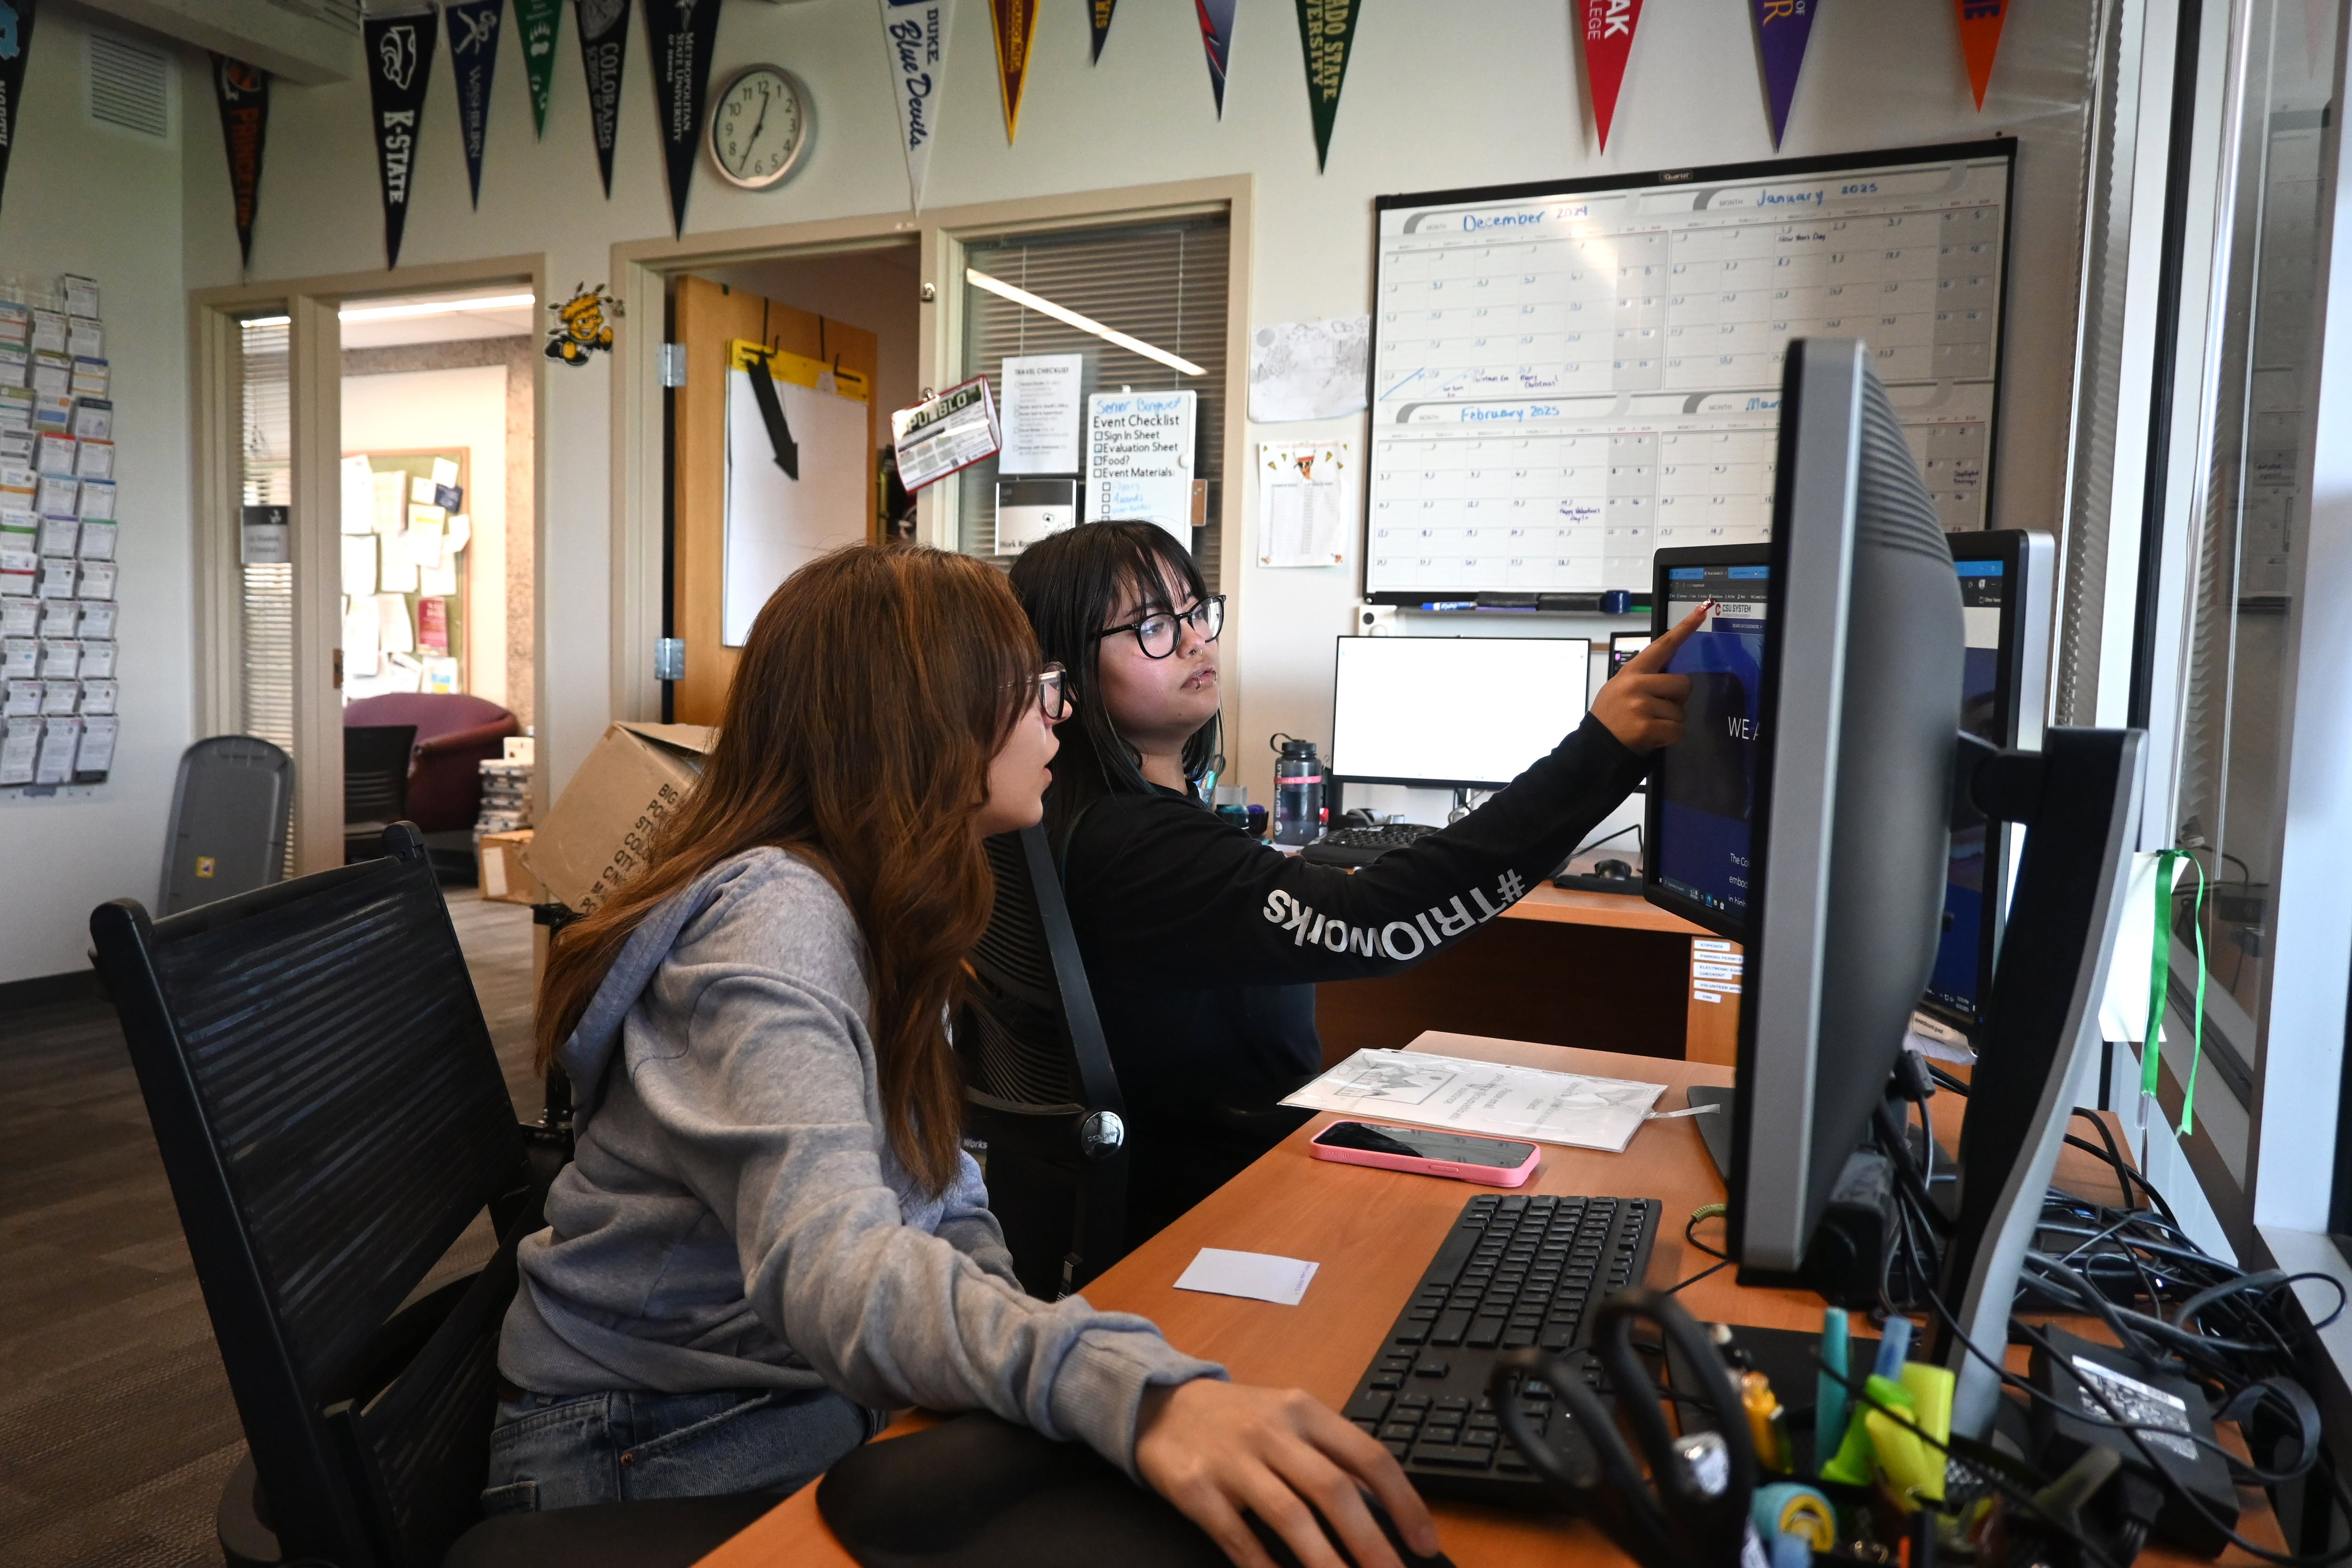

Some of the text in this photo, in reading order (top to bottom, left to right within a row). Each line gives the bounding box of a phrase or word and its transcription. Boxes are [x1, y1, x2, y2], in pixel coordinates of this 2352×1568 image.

[927, 8, 939, 65] DUKE
[1323, 40, 1344, 103] STATE
[673, 32, 685, 143] STATE UNIVERSITY
[683, 32, 695, 132] METROPOLITAN
[757, 80, 769, 95] 12
[889, 20, 932, 152] Blue Devils
[600, 42, 620, 150] COLORADO
[742, 87, 752, 101] 11
[776, 85, 781, 98] 1
[727, 102, 742, 117] 10
[786, 99, 793, 113] 2
[725, 122, 733, 136] 9
[729, 142, 736, 157] 8
[783, 138, 791, 153] 4
[383, 110, 414, 202] K-STATE
[771, 153, 779, 167] 5
[755, 160, 763, 174] 6
[1757, 183, 1878, 207] January 2025
[1462, 205, 1588, 232] December 2024
[1093, 414, 1179, 429] Event Checklist
[1461, 405, 1560, 423] February 2025
[1104, 430, 1160, 443] Sign In Sheet
[1103, 441, 1178, 453] Evaluation Sheet
[1103, 454, 1130, 466] Food?
[1103, 466, 1175, 478] Event Materials:
[1728, 716, 1750, 740] WE
[614, 850, 636, 872] QTY
[1730, 852, 1740, 865] The
[1728, 894, 1733, 903] in
